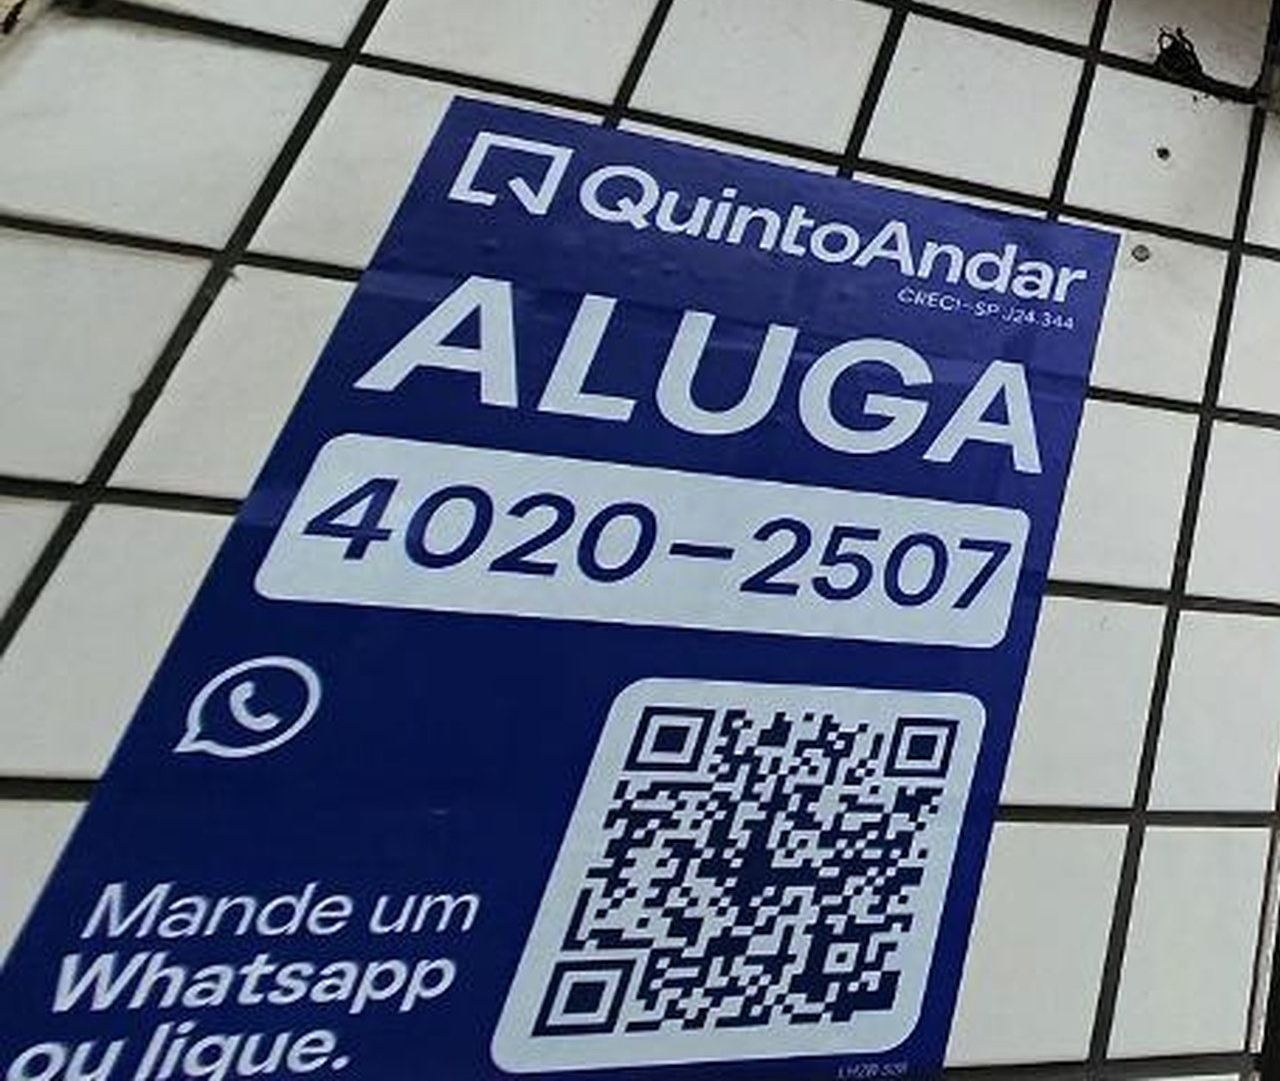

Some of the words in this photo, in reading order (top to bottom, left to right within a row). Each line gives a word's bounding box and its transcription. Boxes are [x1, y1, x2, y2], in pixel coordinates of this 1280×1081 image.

[578, 163, 1087, 304] QuintoAndar
[354, 276, 1043, 475] ALUGA
[302, 476, 1014, 611] 4020-2507
[80, 882, 354, 939] Mande
[369, 893, 481, 935] um
[52, 951, 457, 1014] Whatsapp
